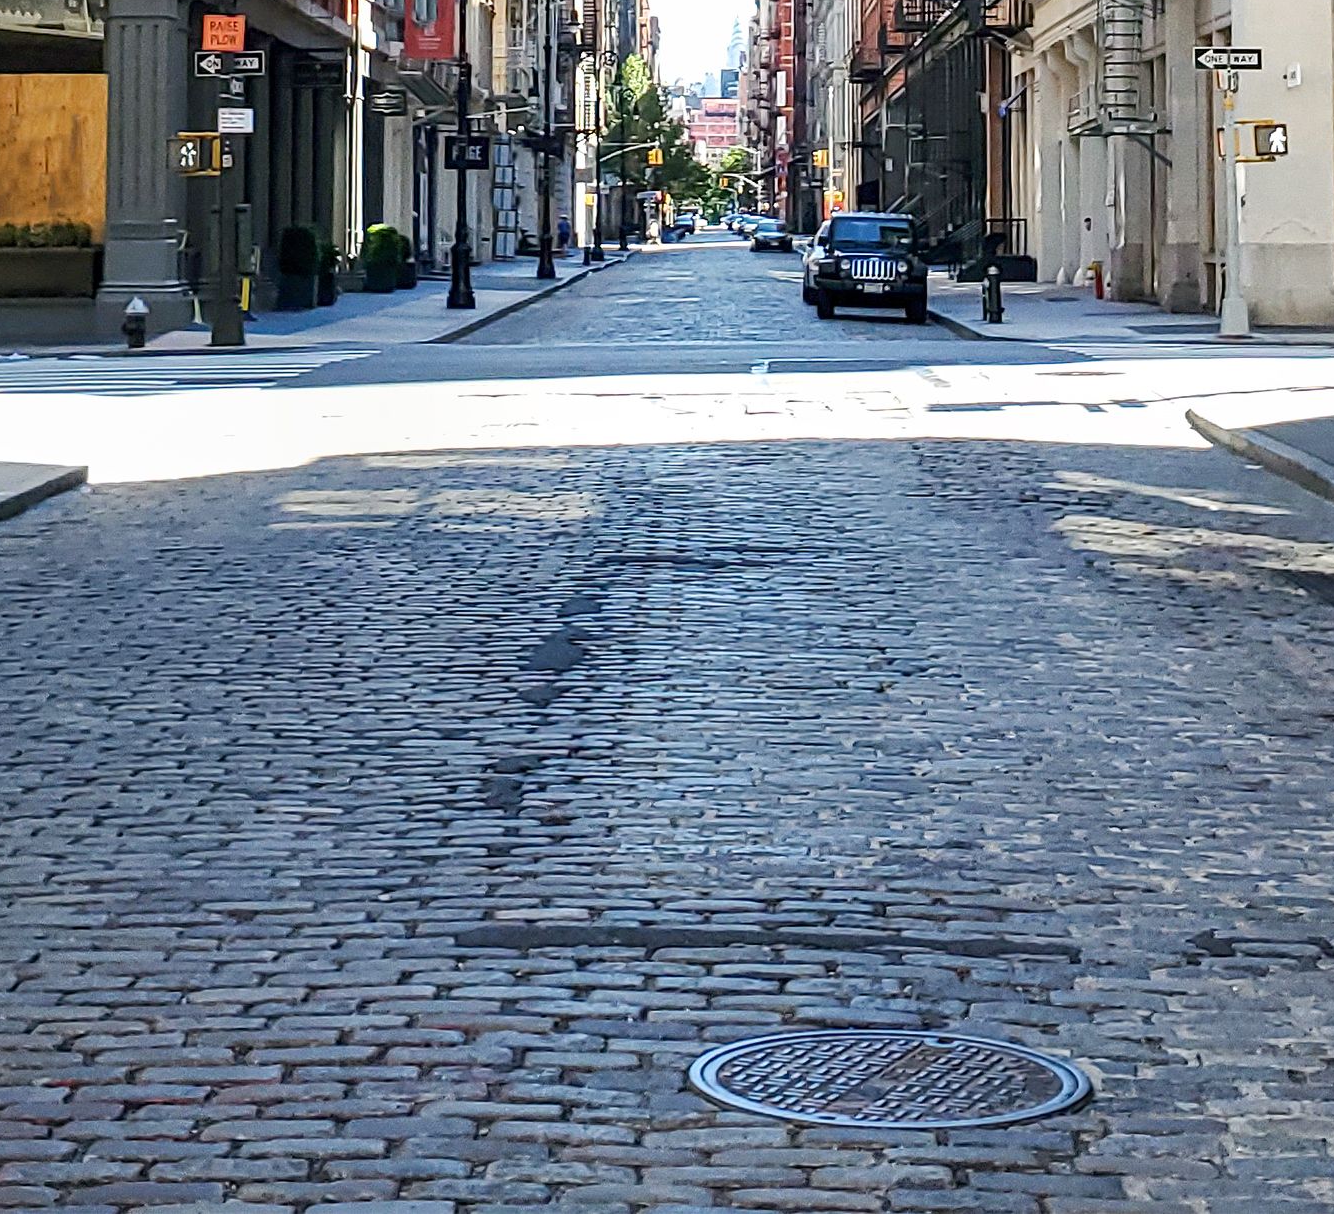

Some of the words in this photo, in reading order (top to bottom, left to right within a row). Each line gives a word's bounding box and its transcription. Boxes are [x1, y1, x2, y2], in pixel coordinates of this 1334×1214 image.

[209, 21, 239, 33] RAISE
[210, 35, 237, 45] PLOW
[1204, 55, 1224, 64] ONE
[1233, 55, 1254, 63] WAY
